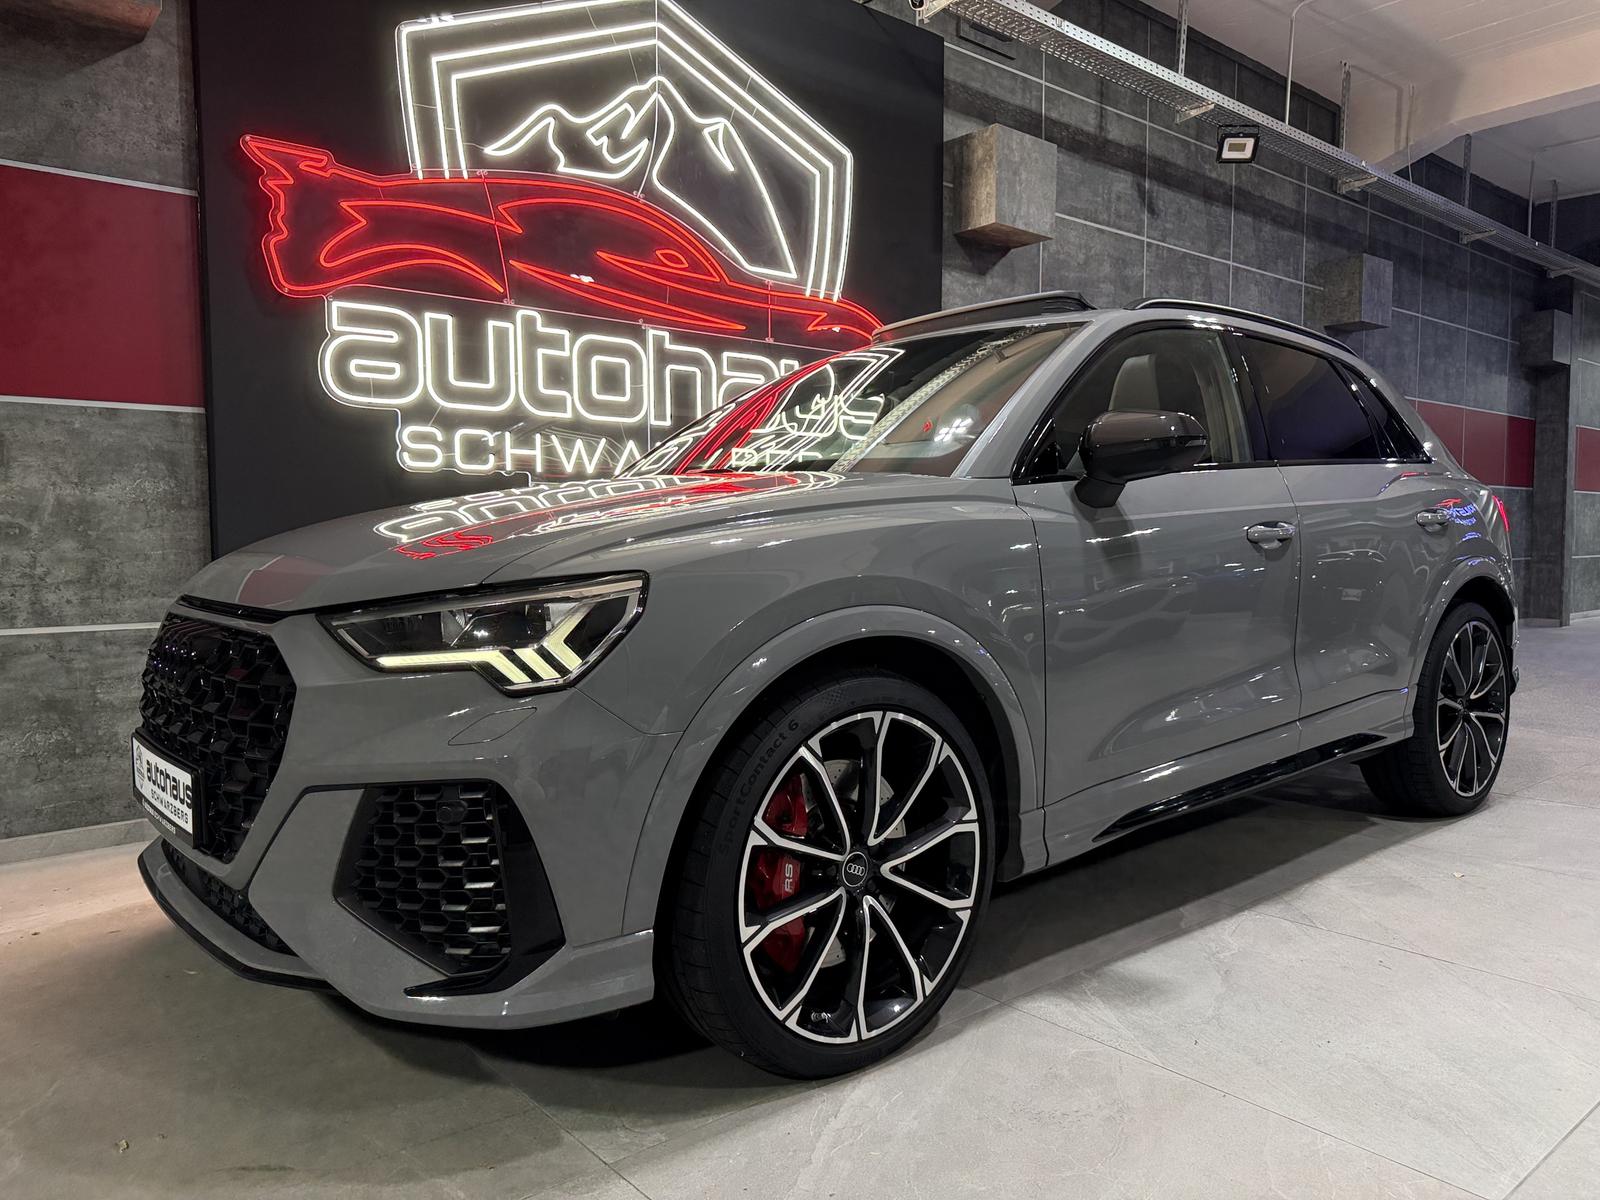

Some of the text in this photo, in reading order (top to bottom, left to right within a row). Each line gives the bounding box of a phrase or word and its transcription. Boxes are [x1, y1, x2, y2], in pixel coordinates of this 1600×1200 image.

[788, 719, 799, 732] 6
[146, 759, 192, 810] autohaus
[150, 788, 189, 824] SCHWARZBERG
[785, 863, 793, 893] RS
